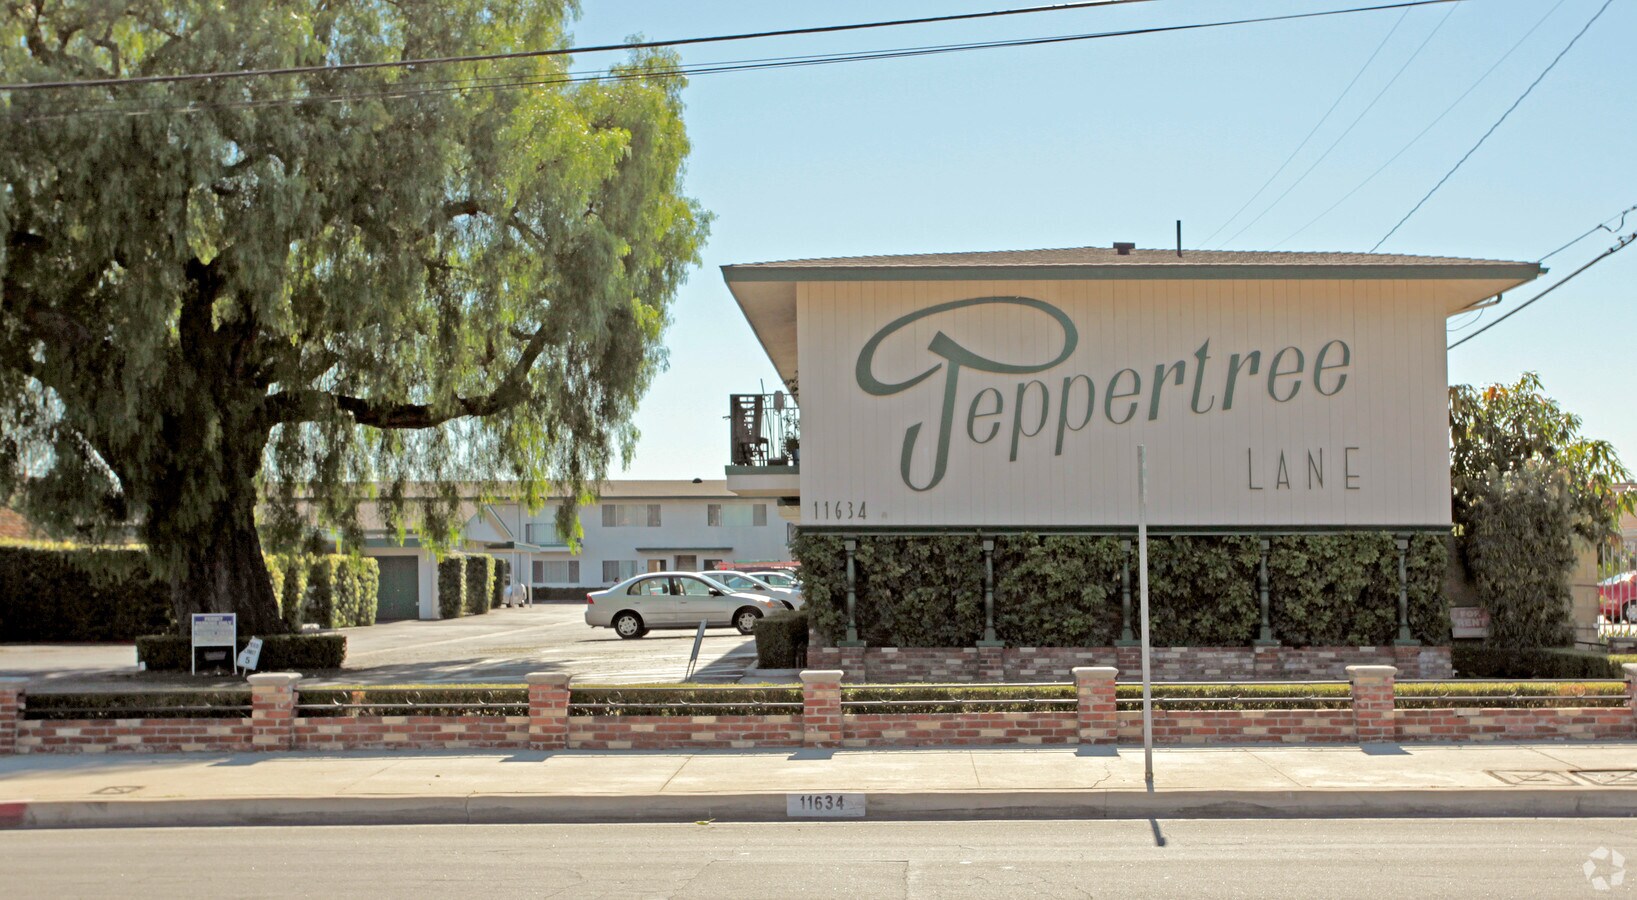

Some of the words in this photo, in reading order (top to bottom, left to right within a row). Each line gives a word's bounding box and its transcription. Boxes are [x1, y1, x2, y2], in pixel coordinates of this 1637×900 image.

[854, 295, 1352, 493] Peppertree
[1248, 447, 1361, 490] LANE
[814, 501, 867, 520] 11634
[244, 656, 251, 664] 5
[800, 795, 845, 810] 11634
